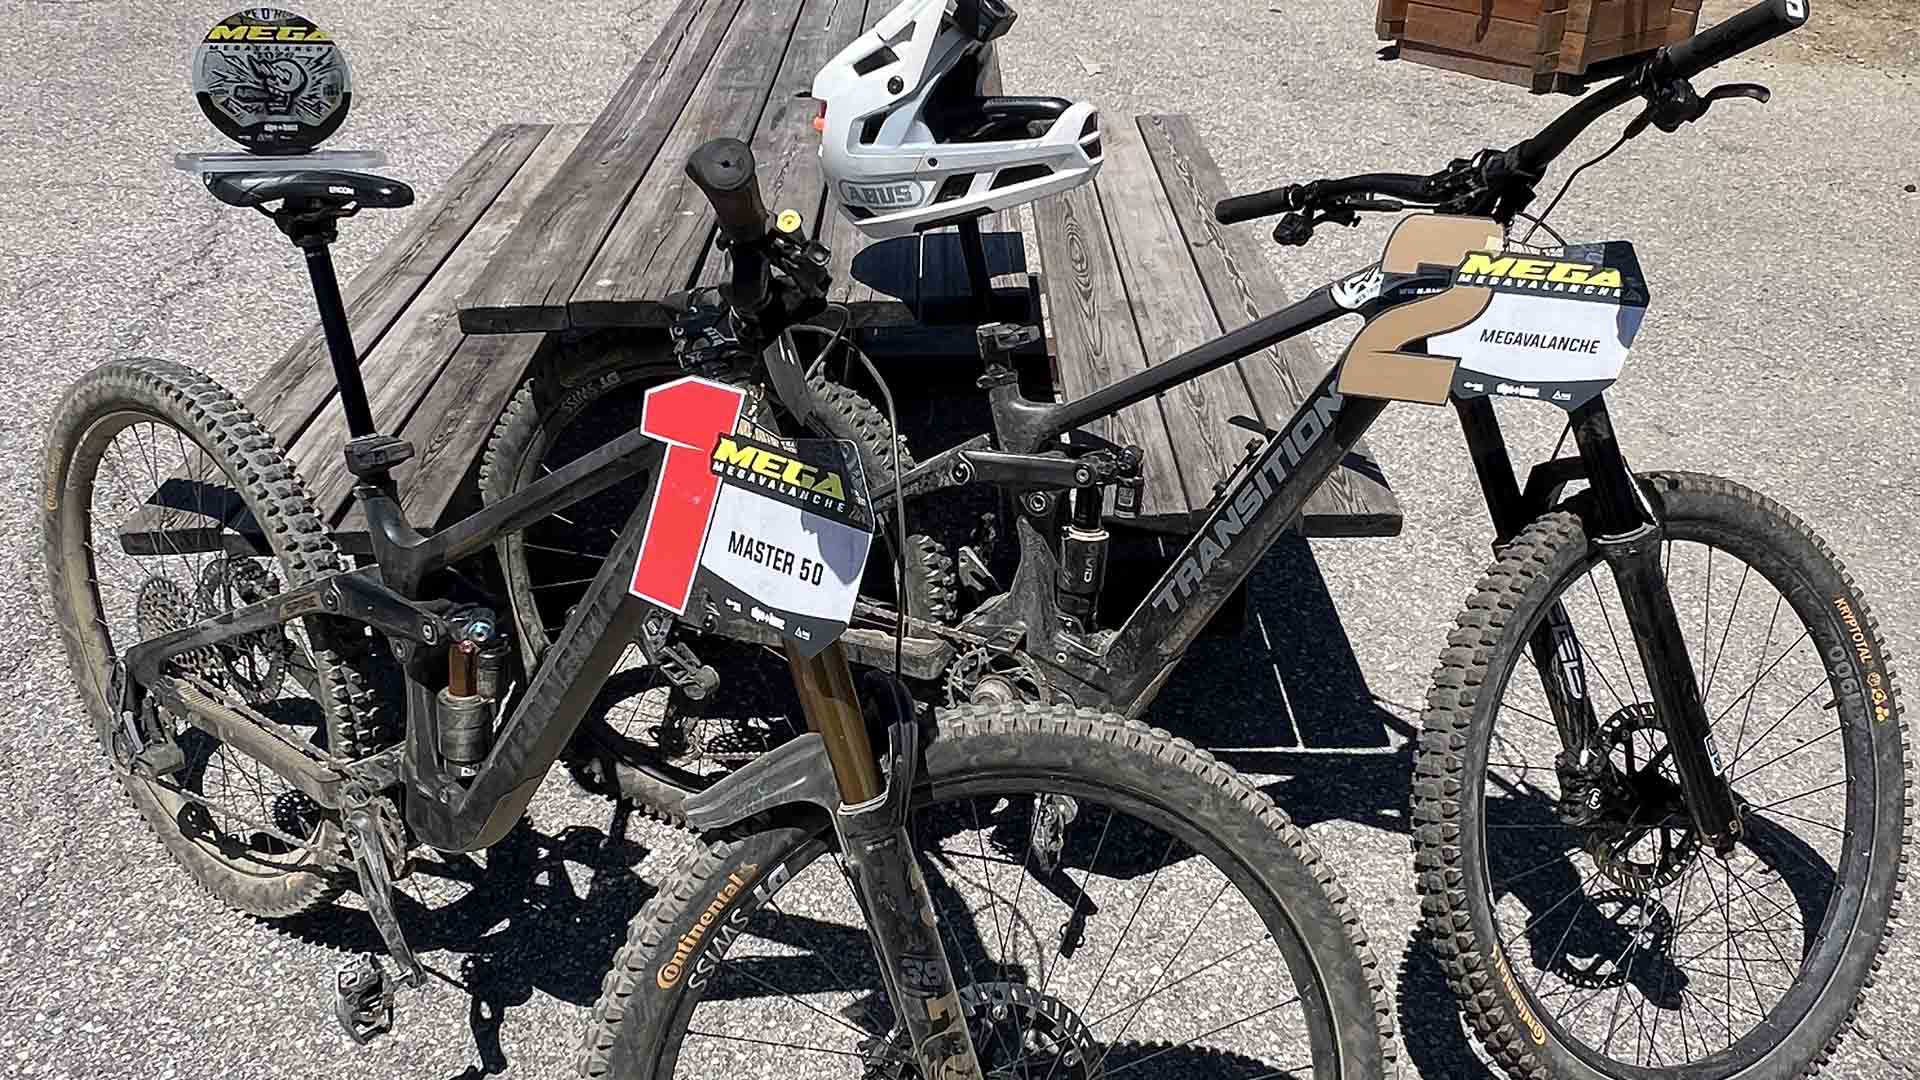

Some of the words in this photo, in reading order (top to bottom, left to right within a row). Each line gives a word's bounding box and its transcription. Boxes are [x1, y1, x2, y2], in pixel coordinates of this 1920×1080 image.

[208, 26, 333, 41] MEGA
[848, 184, 913, 204] ABUS
[1457, 272, 1624, 298] MEGAVALANCHE
[1459, 254, 1622, 288] MEGA
[1480, 328, 1601, 354] MEGAVALANCHE
[712, 462, 846, 513] MEGAVALANCHE
[713, 438, 846, 501] MEGA
[1152, 379, 1344, 613] TRANSITION
[728, 531, 795, 576] MASTER
[799, 558, 824, 586] 50
[1833, 597, 1872, 664] KRYPTOTAL
[752, 862, 792, 912] DT
[656, 872, 746, 989] Continental
[688, 907, 749, 990] SWISS
